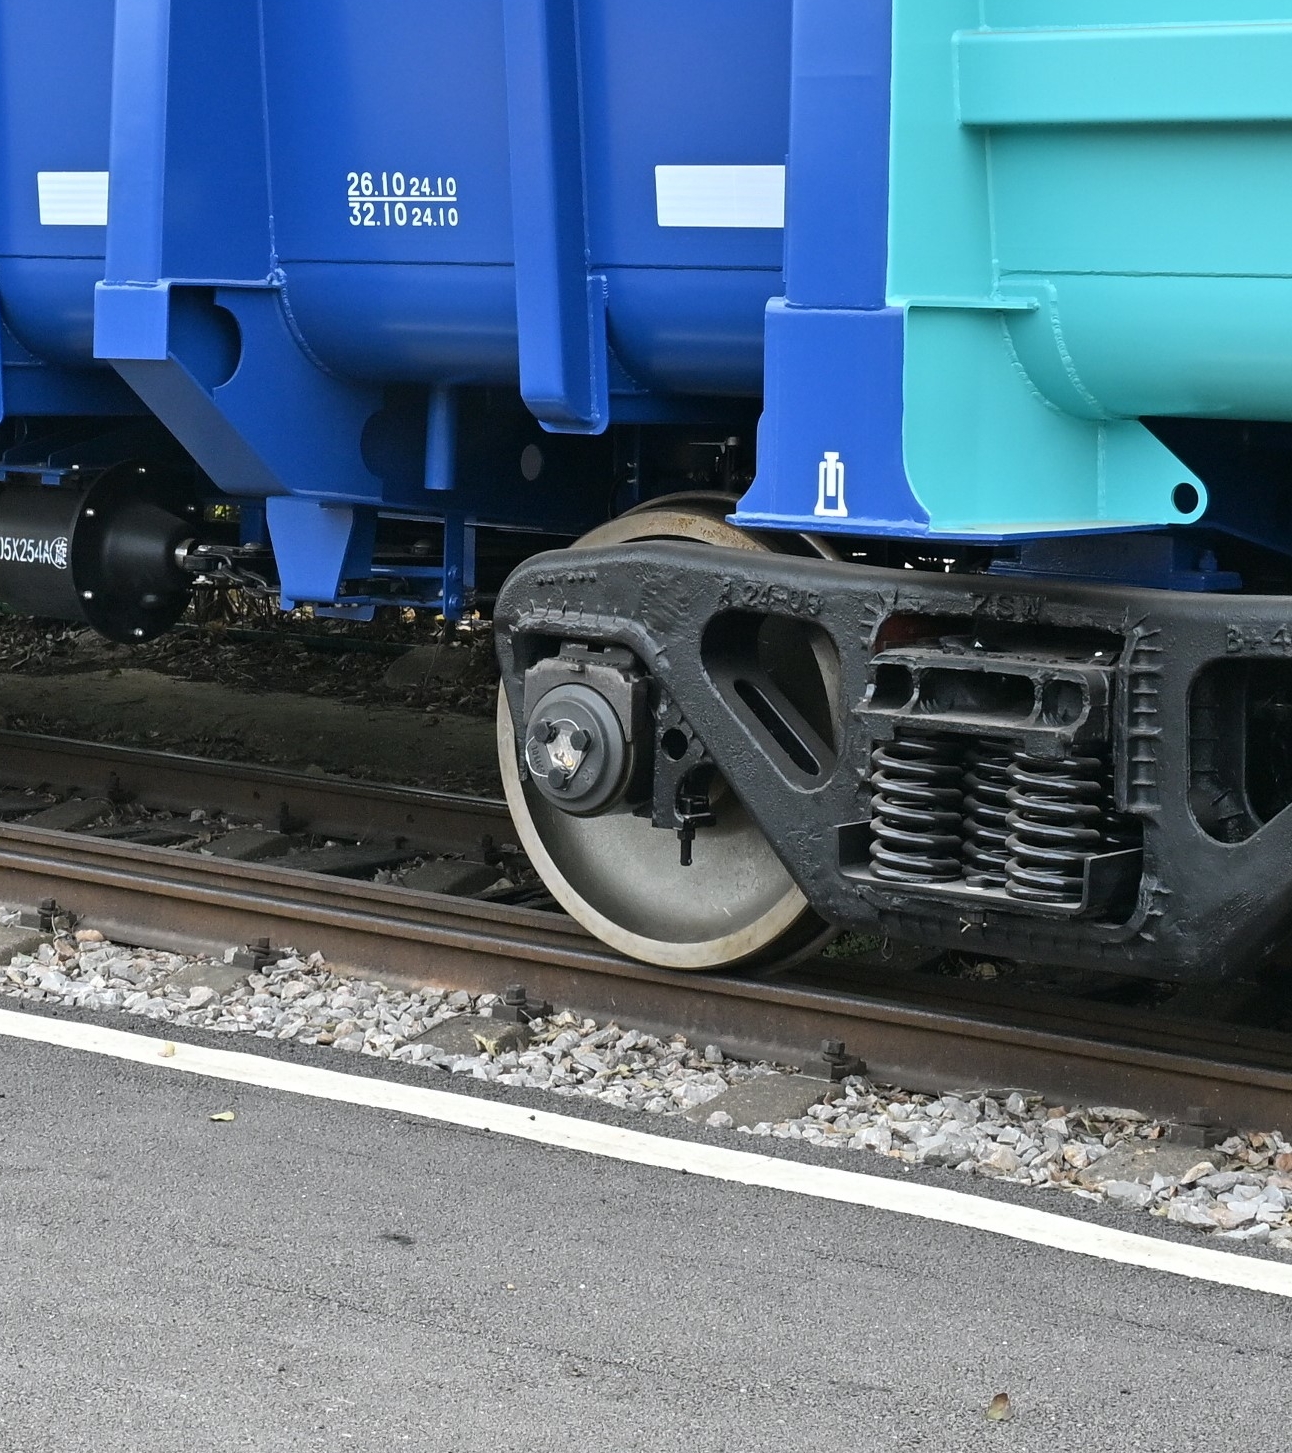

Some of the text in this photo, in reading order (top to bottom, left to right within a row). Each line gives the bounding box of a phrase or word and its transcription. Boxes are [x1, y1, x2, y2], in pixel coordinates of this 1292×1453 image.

[346, 171, 457, 196] 26.10 24.10
[348, 202, 458, 226] 32.10 24.10
